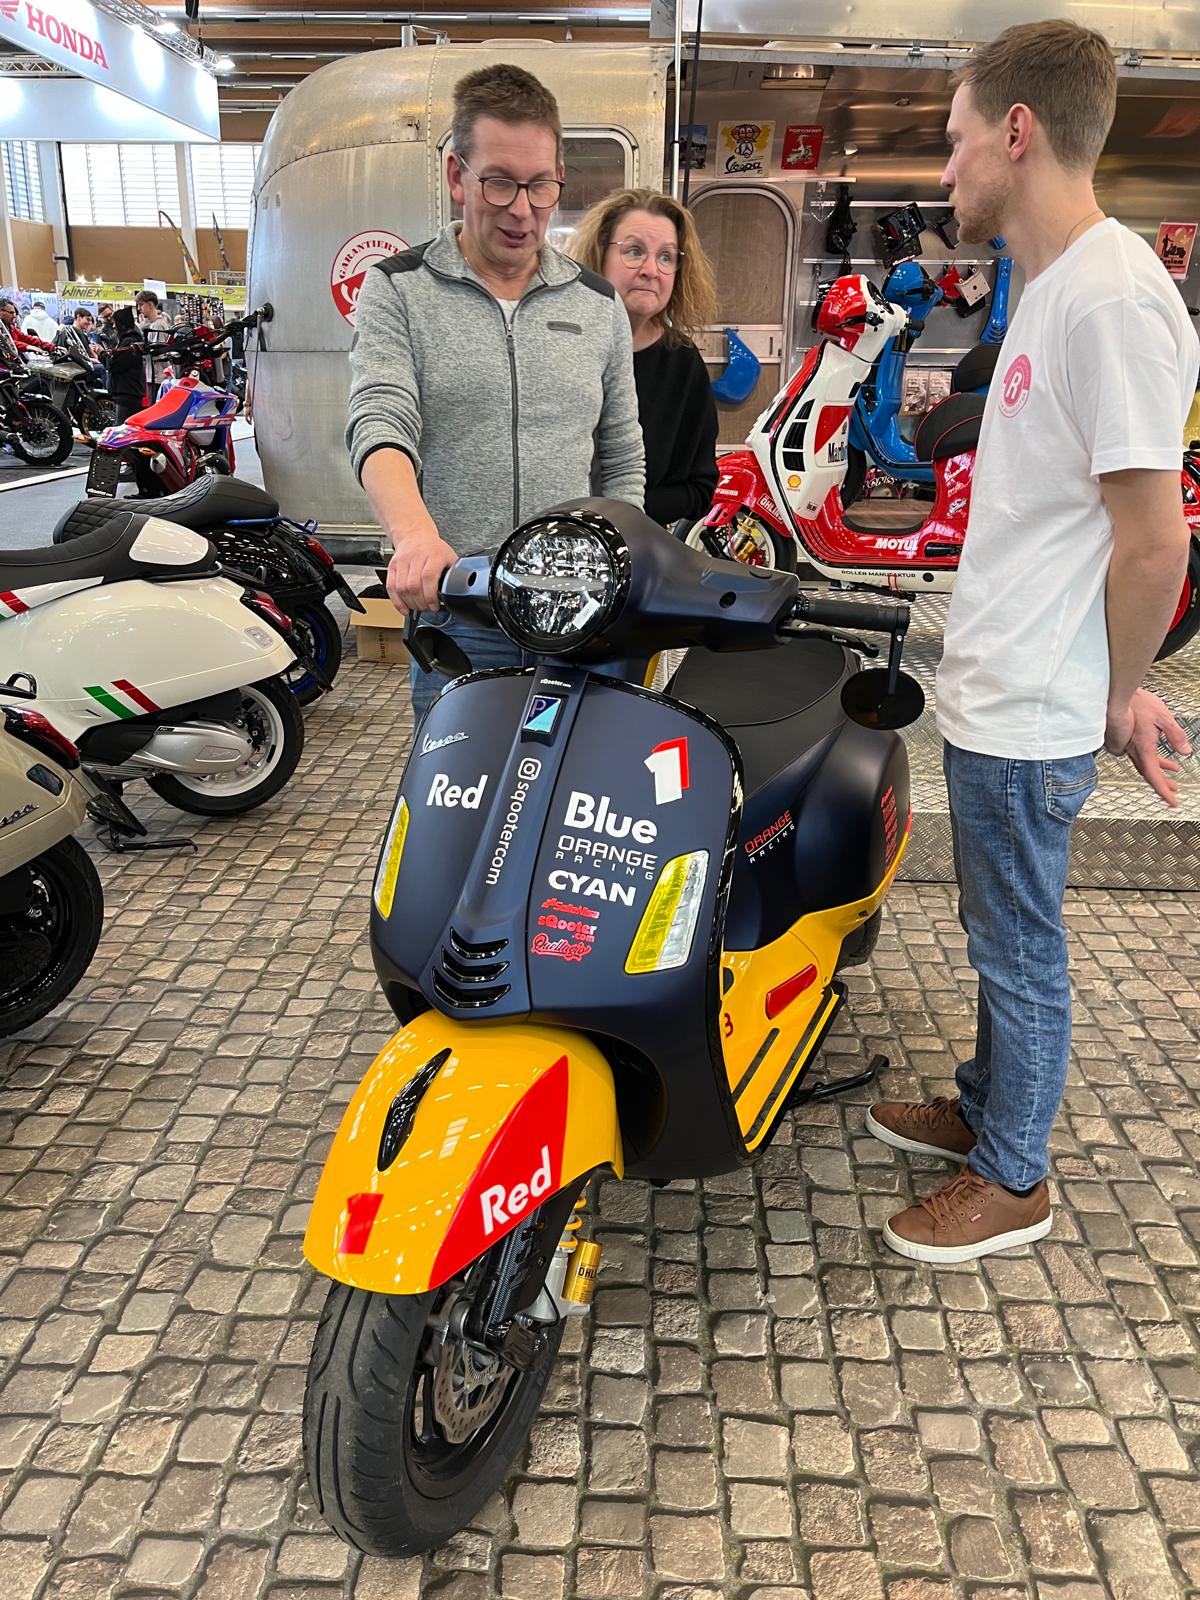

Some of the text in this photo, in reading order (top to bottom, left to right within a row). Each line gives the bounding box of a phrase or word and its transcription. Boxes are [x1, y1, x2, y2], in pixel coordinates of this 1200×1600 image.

[25, 1, 109, 70] HONDA
[724, 155, 763, 175] Vespa
[339, 240, 401, 279] GARANTIERT
[61, 285, 102, 298] WINTEX
[1006, 371, 1023, 400] R
[874, 537, 919, 551] MOTUL
[530, 699, 547, 717] P
[426, 773, 489, 809] Red
[485, 781, 530, 885] sqootercom
[563, 791, 658, 844] Blue
[744, 809, 792, 854] ORANGE
[558, 834, 658, 871] ORANGE
[749, 823, 795, 864] RACING
[555, 850, 654, 881] RACING
[548, 869, 637, 907] CYAN
[538, 914, 597, 935] sQooter
[480, 1145, 552, 1236] Red
